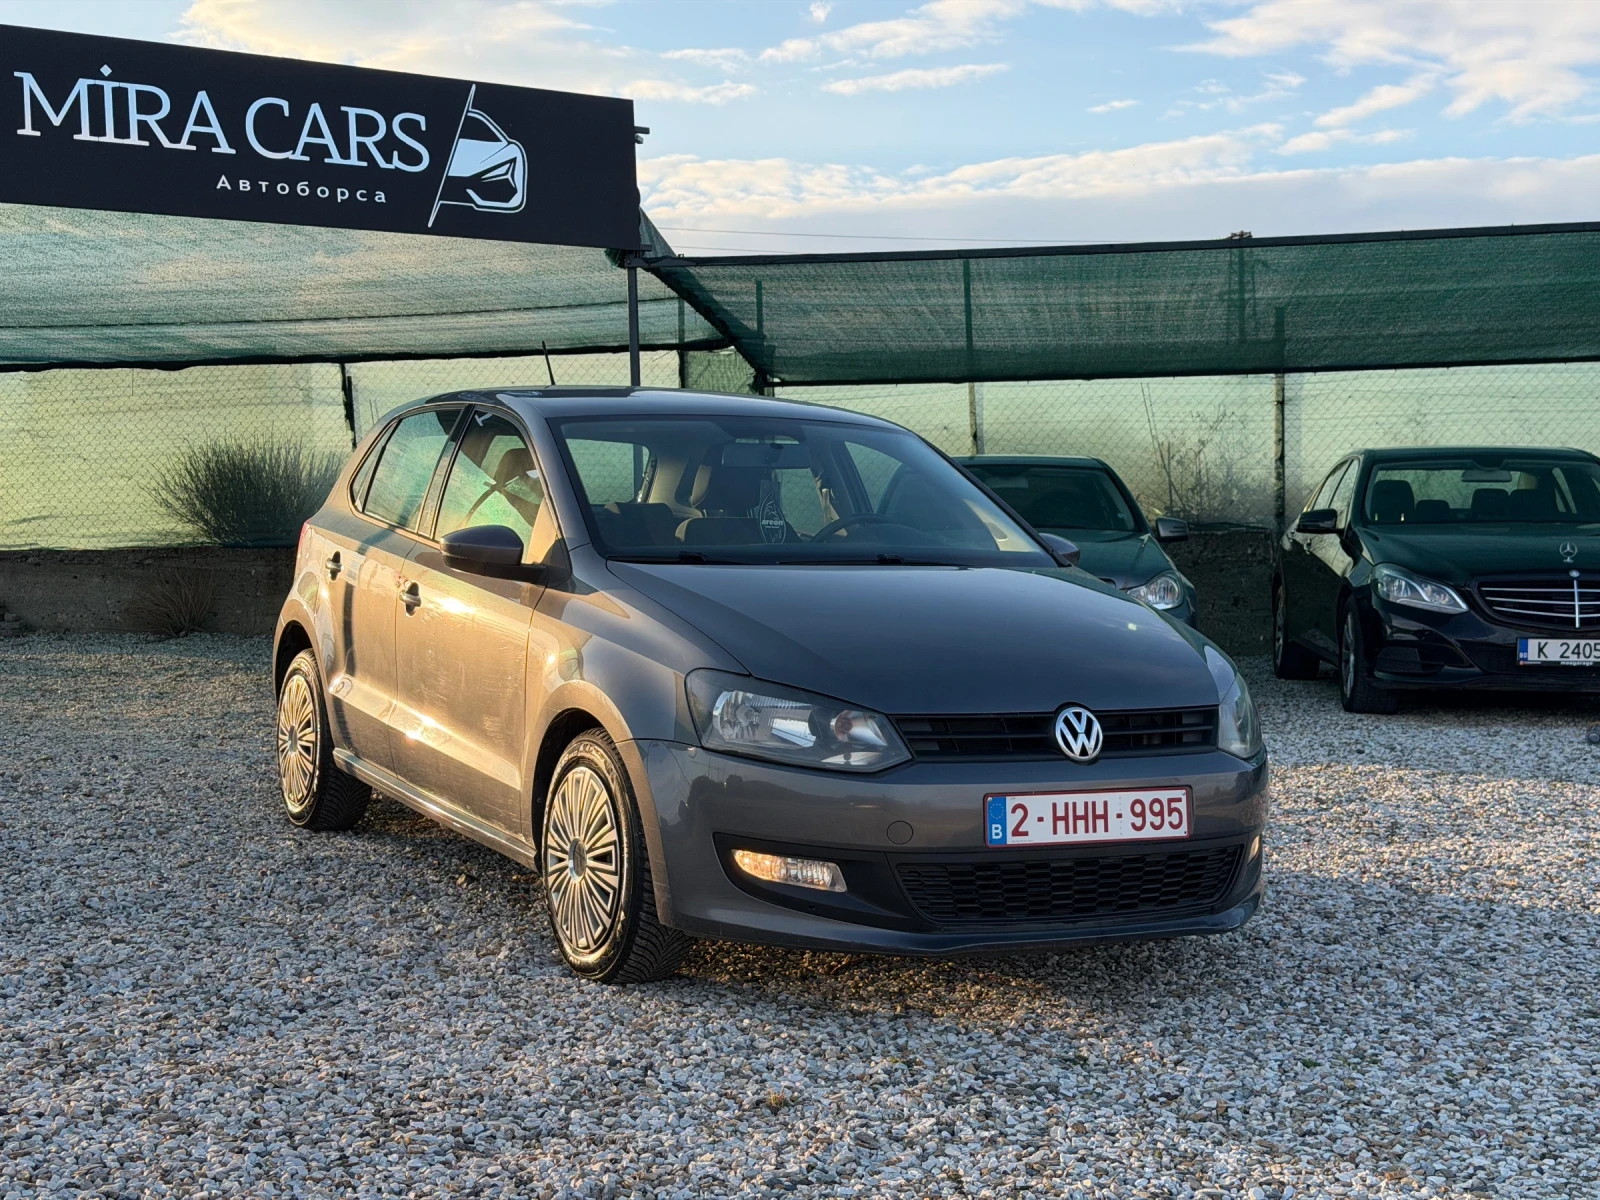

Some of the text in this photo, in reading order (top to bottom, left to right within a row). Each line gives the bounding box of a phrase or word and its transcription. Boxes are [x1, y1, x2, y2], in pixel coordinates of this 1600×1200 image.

[245, 96, 430, 173] CARS
[216, 174, 387, 203] Автоборса
[1537, 641, 1549, 659] K
[1559, 641, 1600, 659] 2405
[991, 797, 1183, 839] B 2-HHH-995
